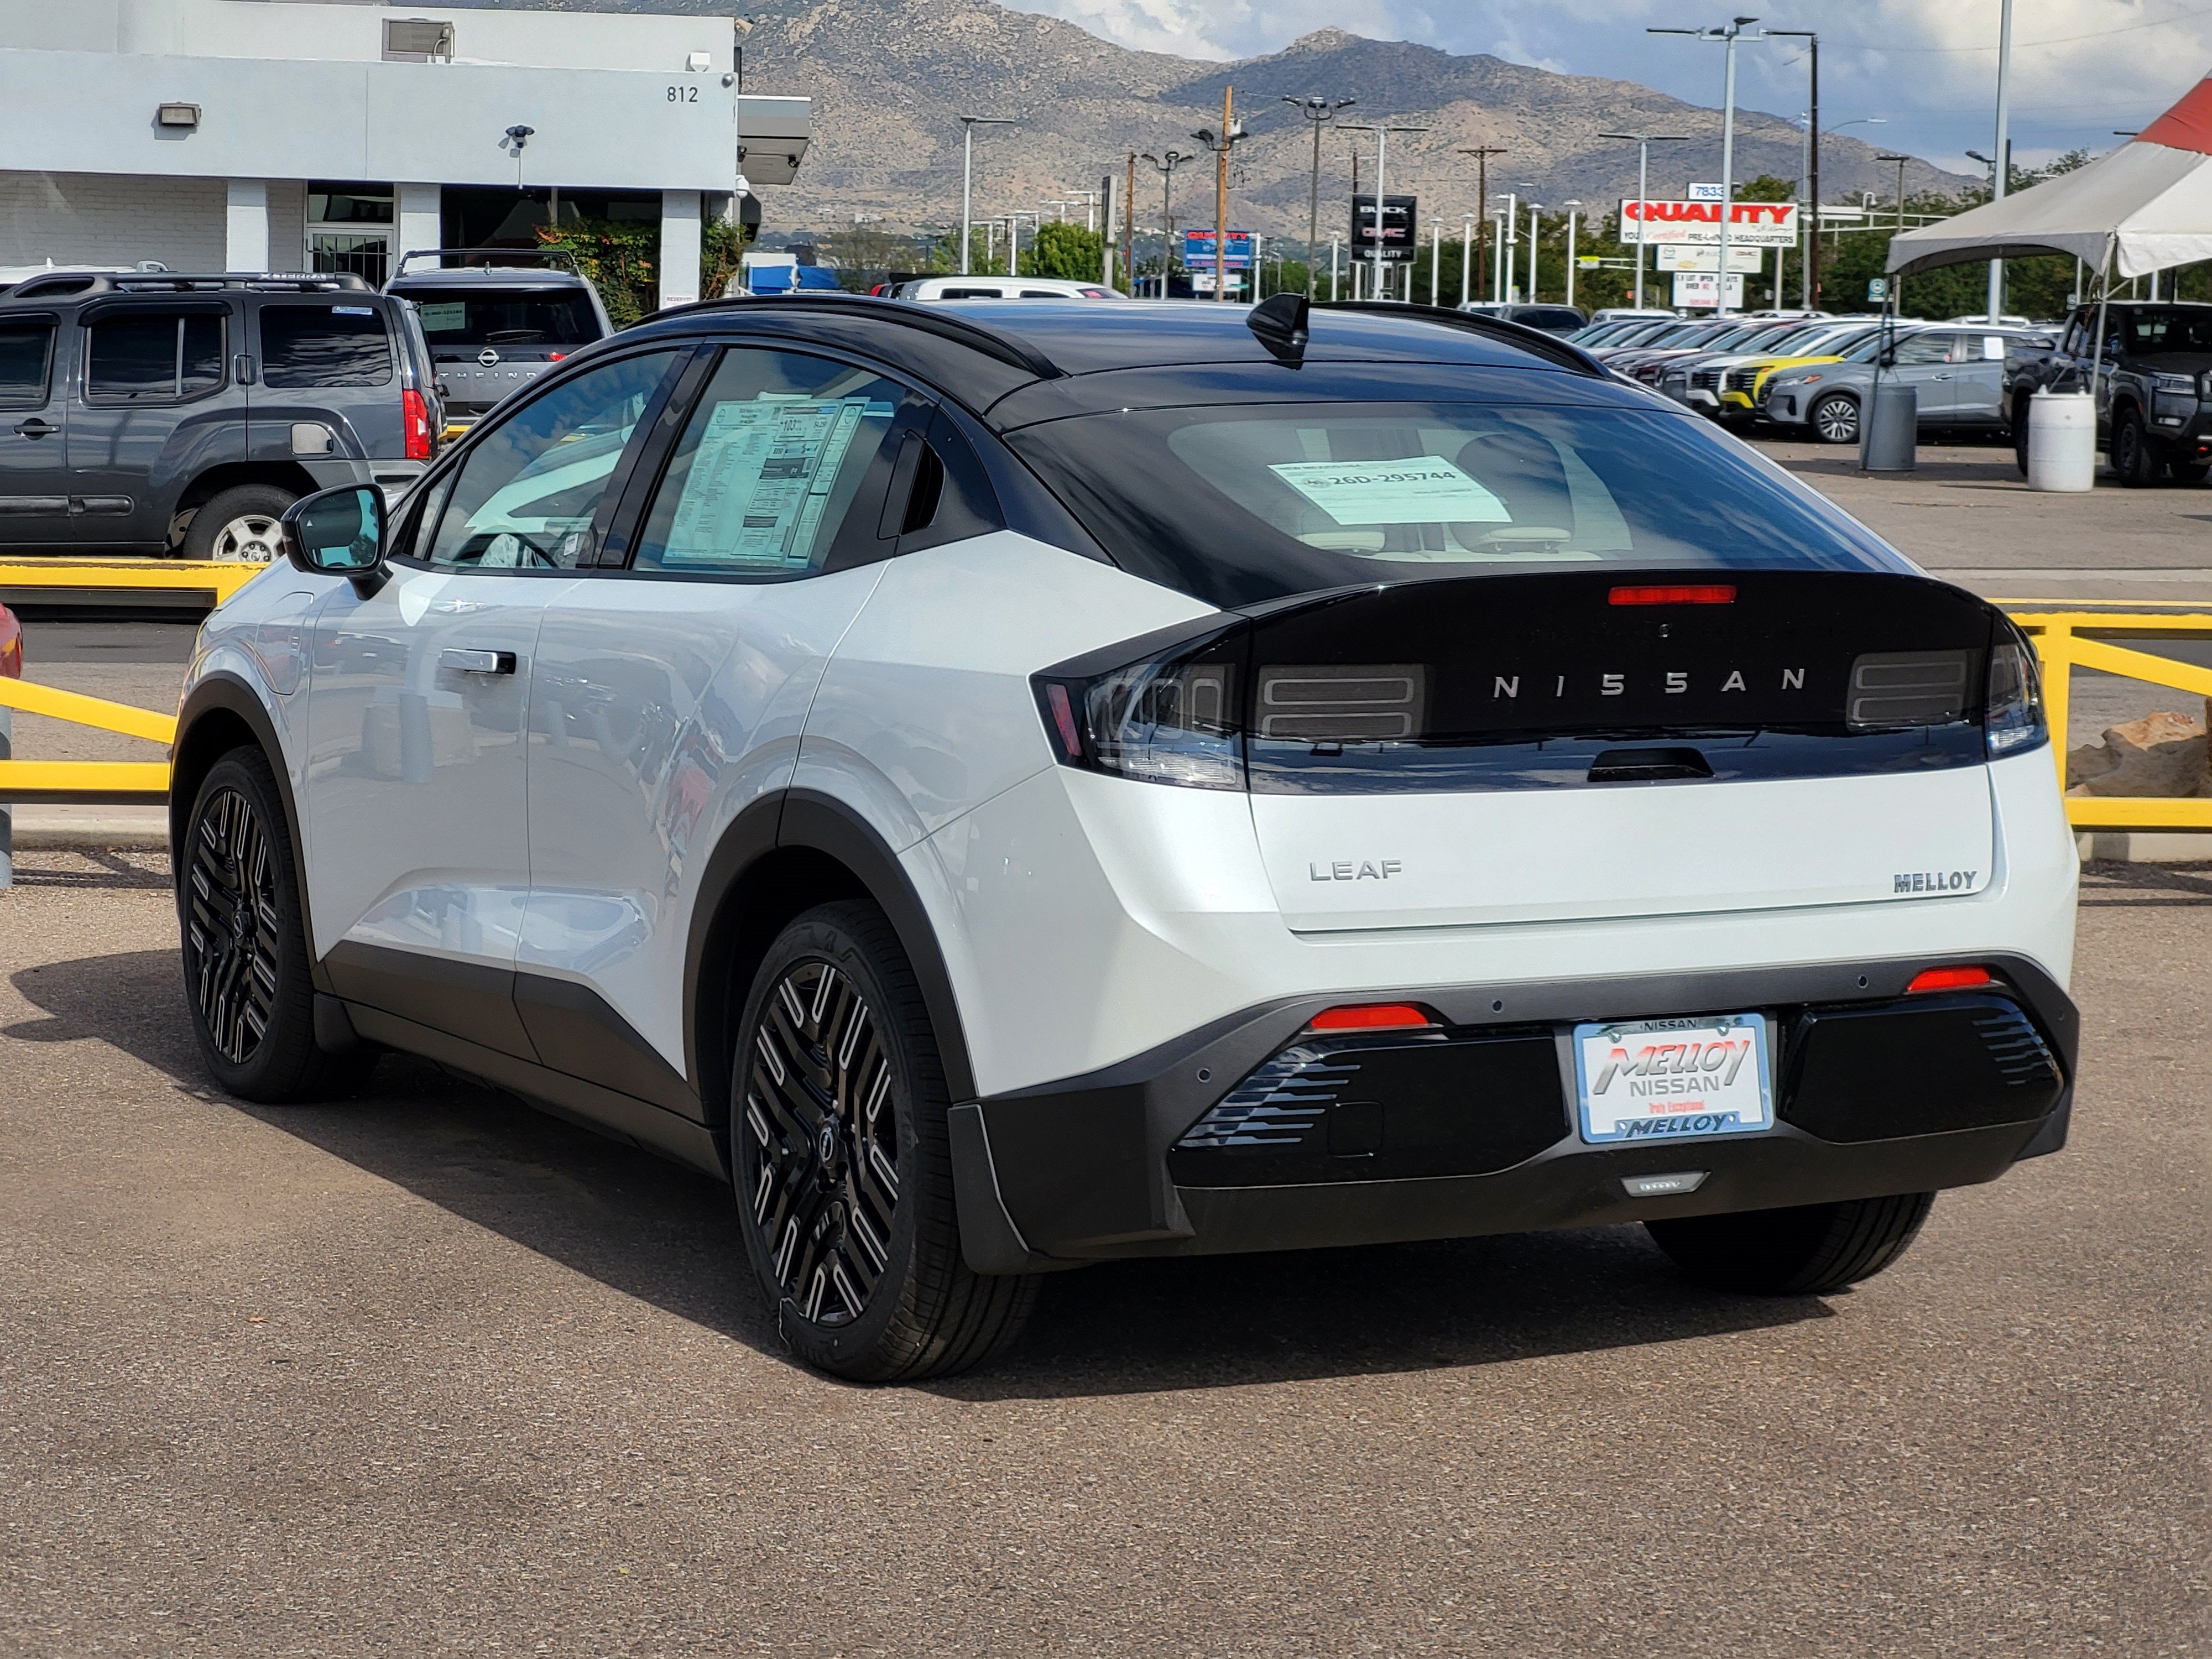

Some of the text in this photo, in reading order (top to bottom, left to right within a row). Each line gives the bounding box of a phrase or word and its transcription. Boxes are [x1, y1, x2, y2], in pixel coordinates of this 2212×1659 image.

[667, 86, 698, 102] 812
[1187, 232, 1248, 240] QUAITY
[1362, 227, 1406, 238] GMC
[1734, 234, 1793, 243] HEADQUARTERS
[1364, 249, 1402, 258] QULITY
[1328, 472, 1455, 485] 26D-295744
[1493, 668, 1805, 698] NISSAN
[1310, 860, 1402, 881] LEAF
[1894, 871, 1977, 893] MELLOY
[1644, 1019, 1697, 1031] NISSAN
[1593, 1040, 1750, 1095] MELLOY
[1630, 1076, 1719, 1097] NISSAN
[1626, 1114, 1726, 1138] MELLOY
